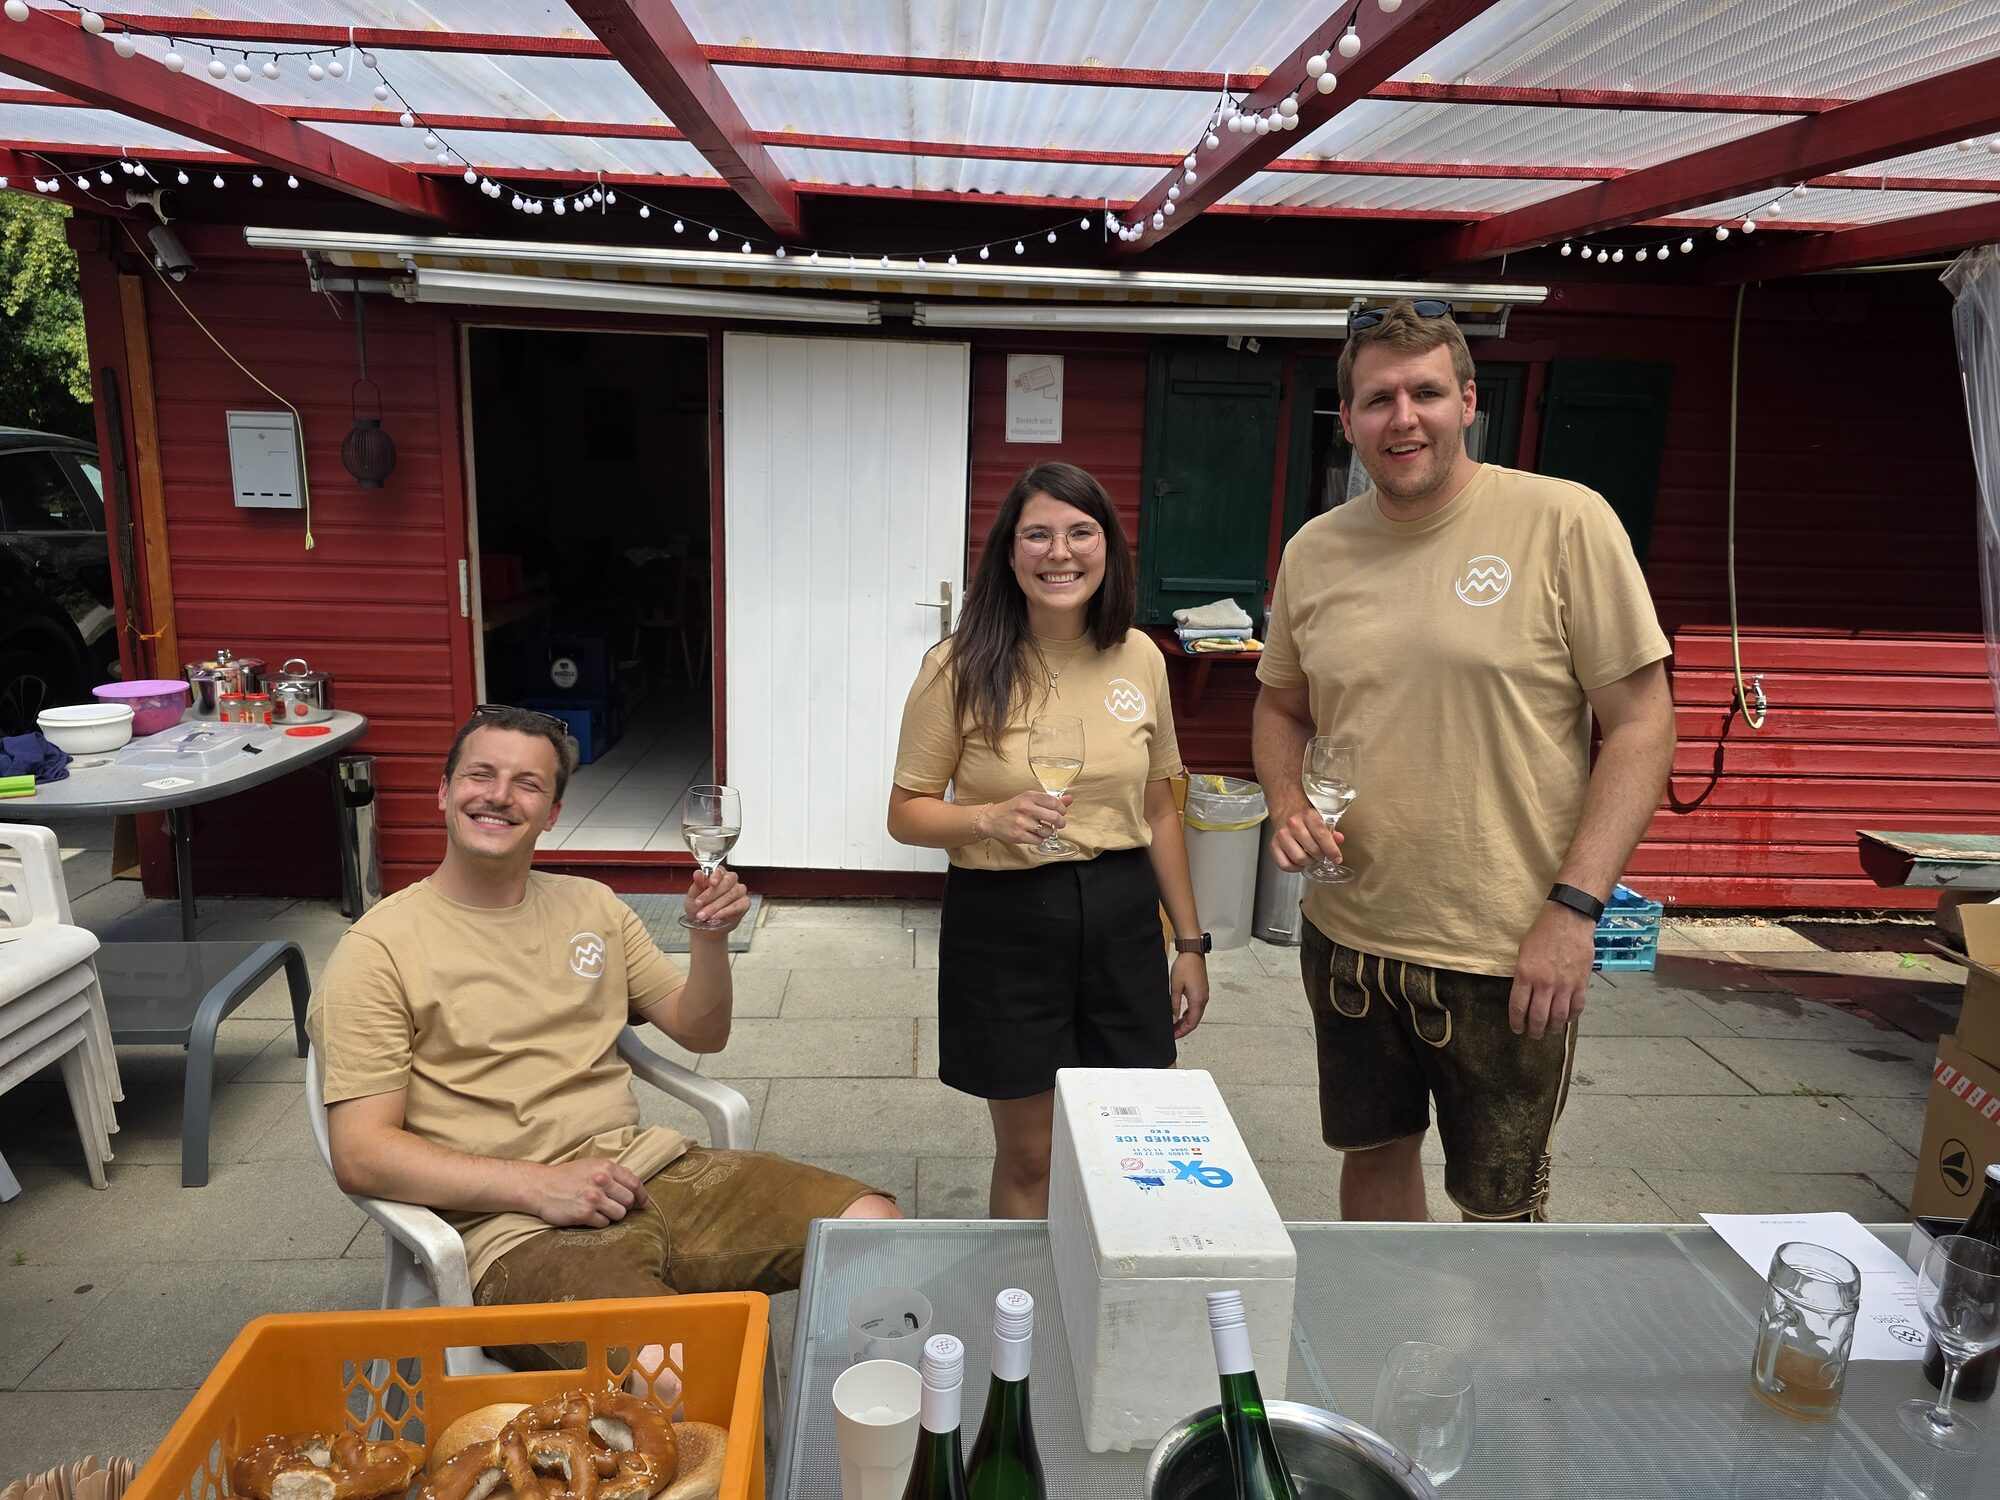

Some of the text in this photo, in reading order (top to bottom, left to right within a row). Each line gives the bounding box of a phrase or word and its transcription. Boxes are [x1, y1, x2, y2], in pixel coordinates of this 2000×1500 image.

[1040, 416, 1053, 424] wird
[1115, 1135, 1211, 1143] CRUSHED ICE
